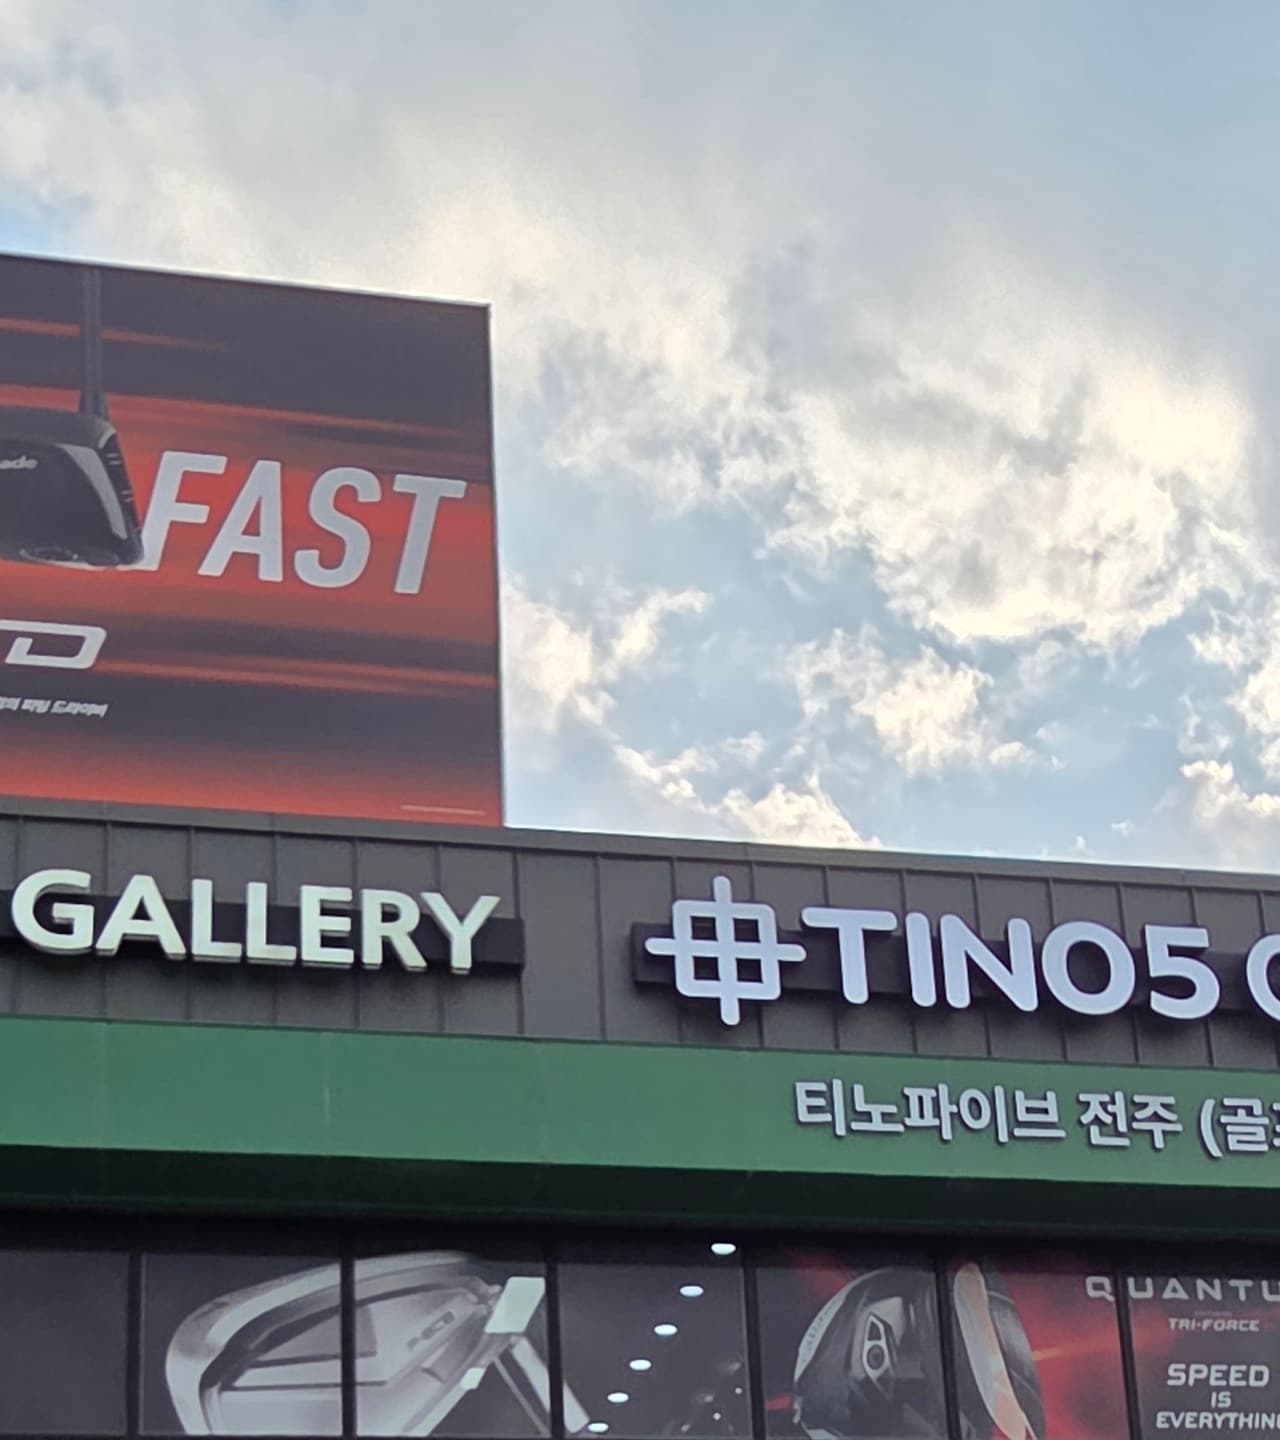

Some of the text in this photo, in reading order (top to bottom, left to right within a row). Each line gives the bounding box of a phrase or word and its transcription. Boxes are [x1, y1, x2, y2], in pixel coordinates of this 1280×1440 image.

[136, 450, 468, 595] FAST
[10, 867, 501, 975] GALLERY
[801, 905, 1222, 1021] TINO5
[793, 1077, 1066, 1145] 티노파이브
[1078, 1089, 1183, 1152] 전주
[1166, 1363, 1271, 1389] SPEED
[1210, 1391, 1232, 1409] IS
